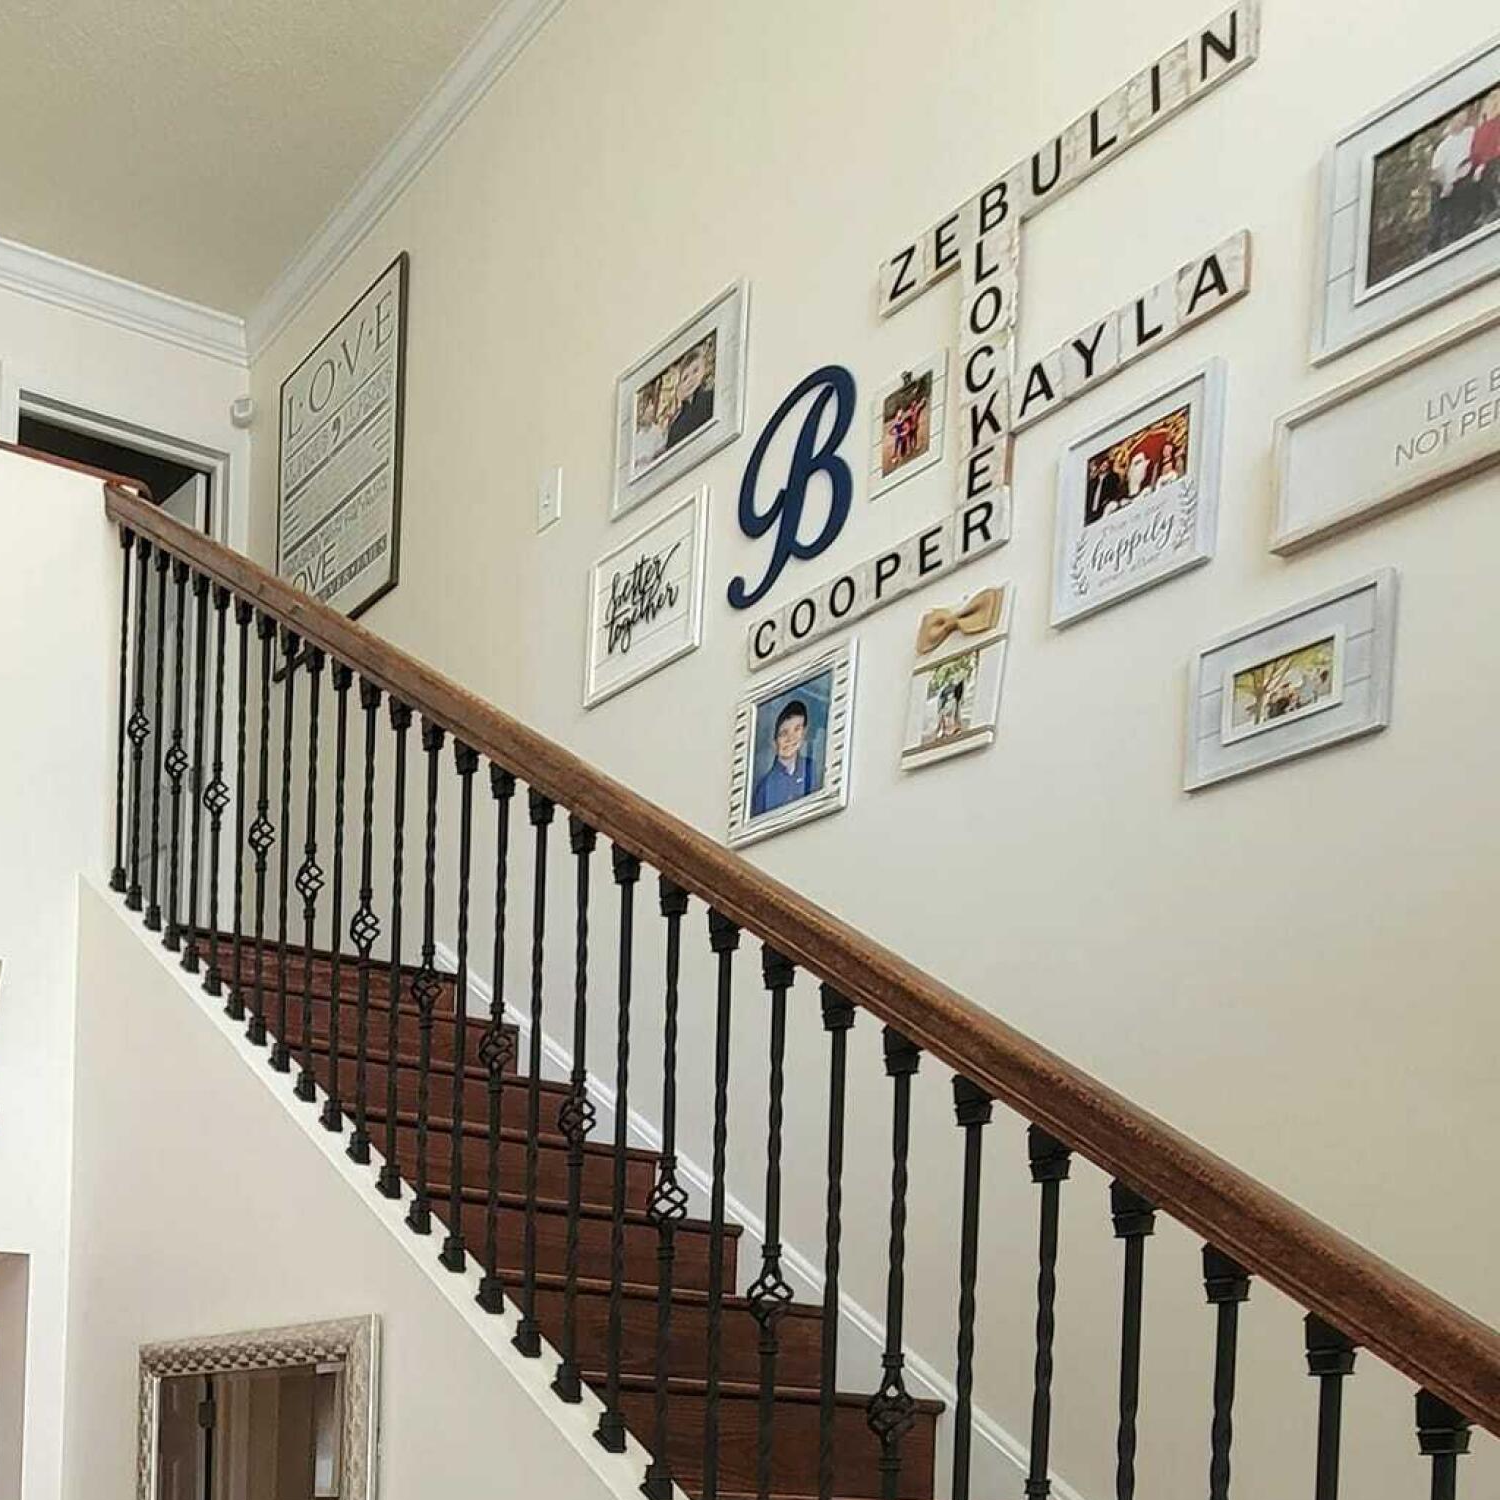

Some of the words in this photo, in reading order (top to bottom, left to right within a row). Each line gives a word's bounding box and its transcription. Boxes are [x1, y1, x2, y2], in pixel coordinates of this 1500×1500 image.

[888, 11, 1238, 301] ZEBULIN
[961, 180, 1009, 553] BLOCKER
[1395, 420, 1451, 467] NOT
[1426, 377, 1478, 421] LIVE
[727, 364, 857, 610] B
[753, 500, 993, 661] COOPER
